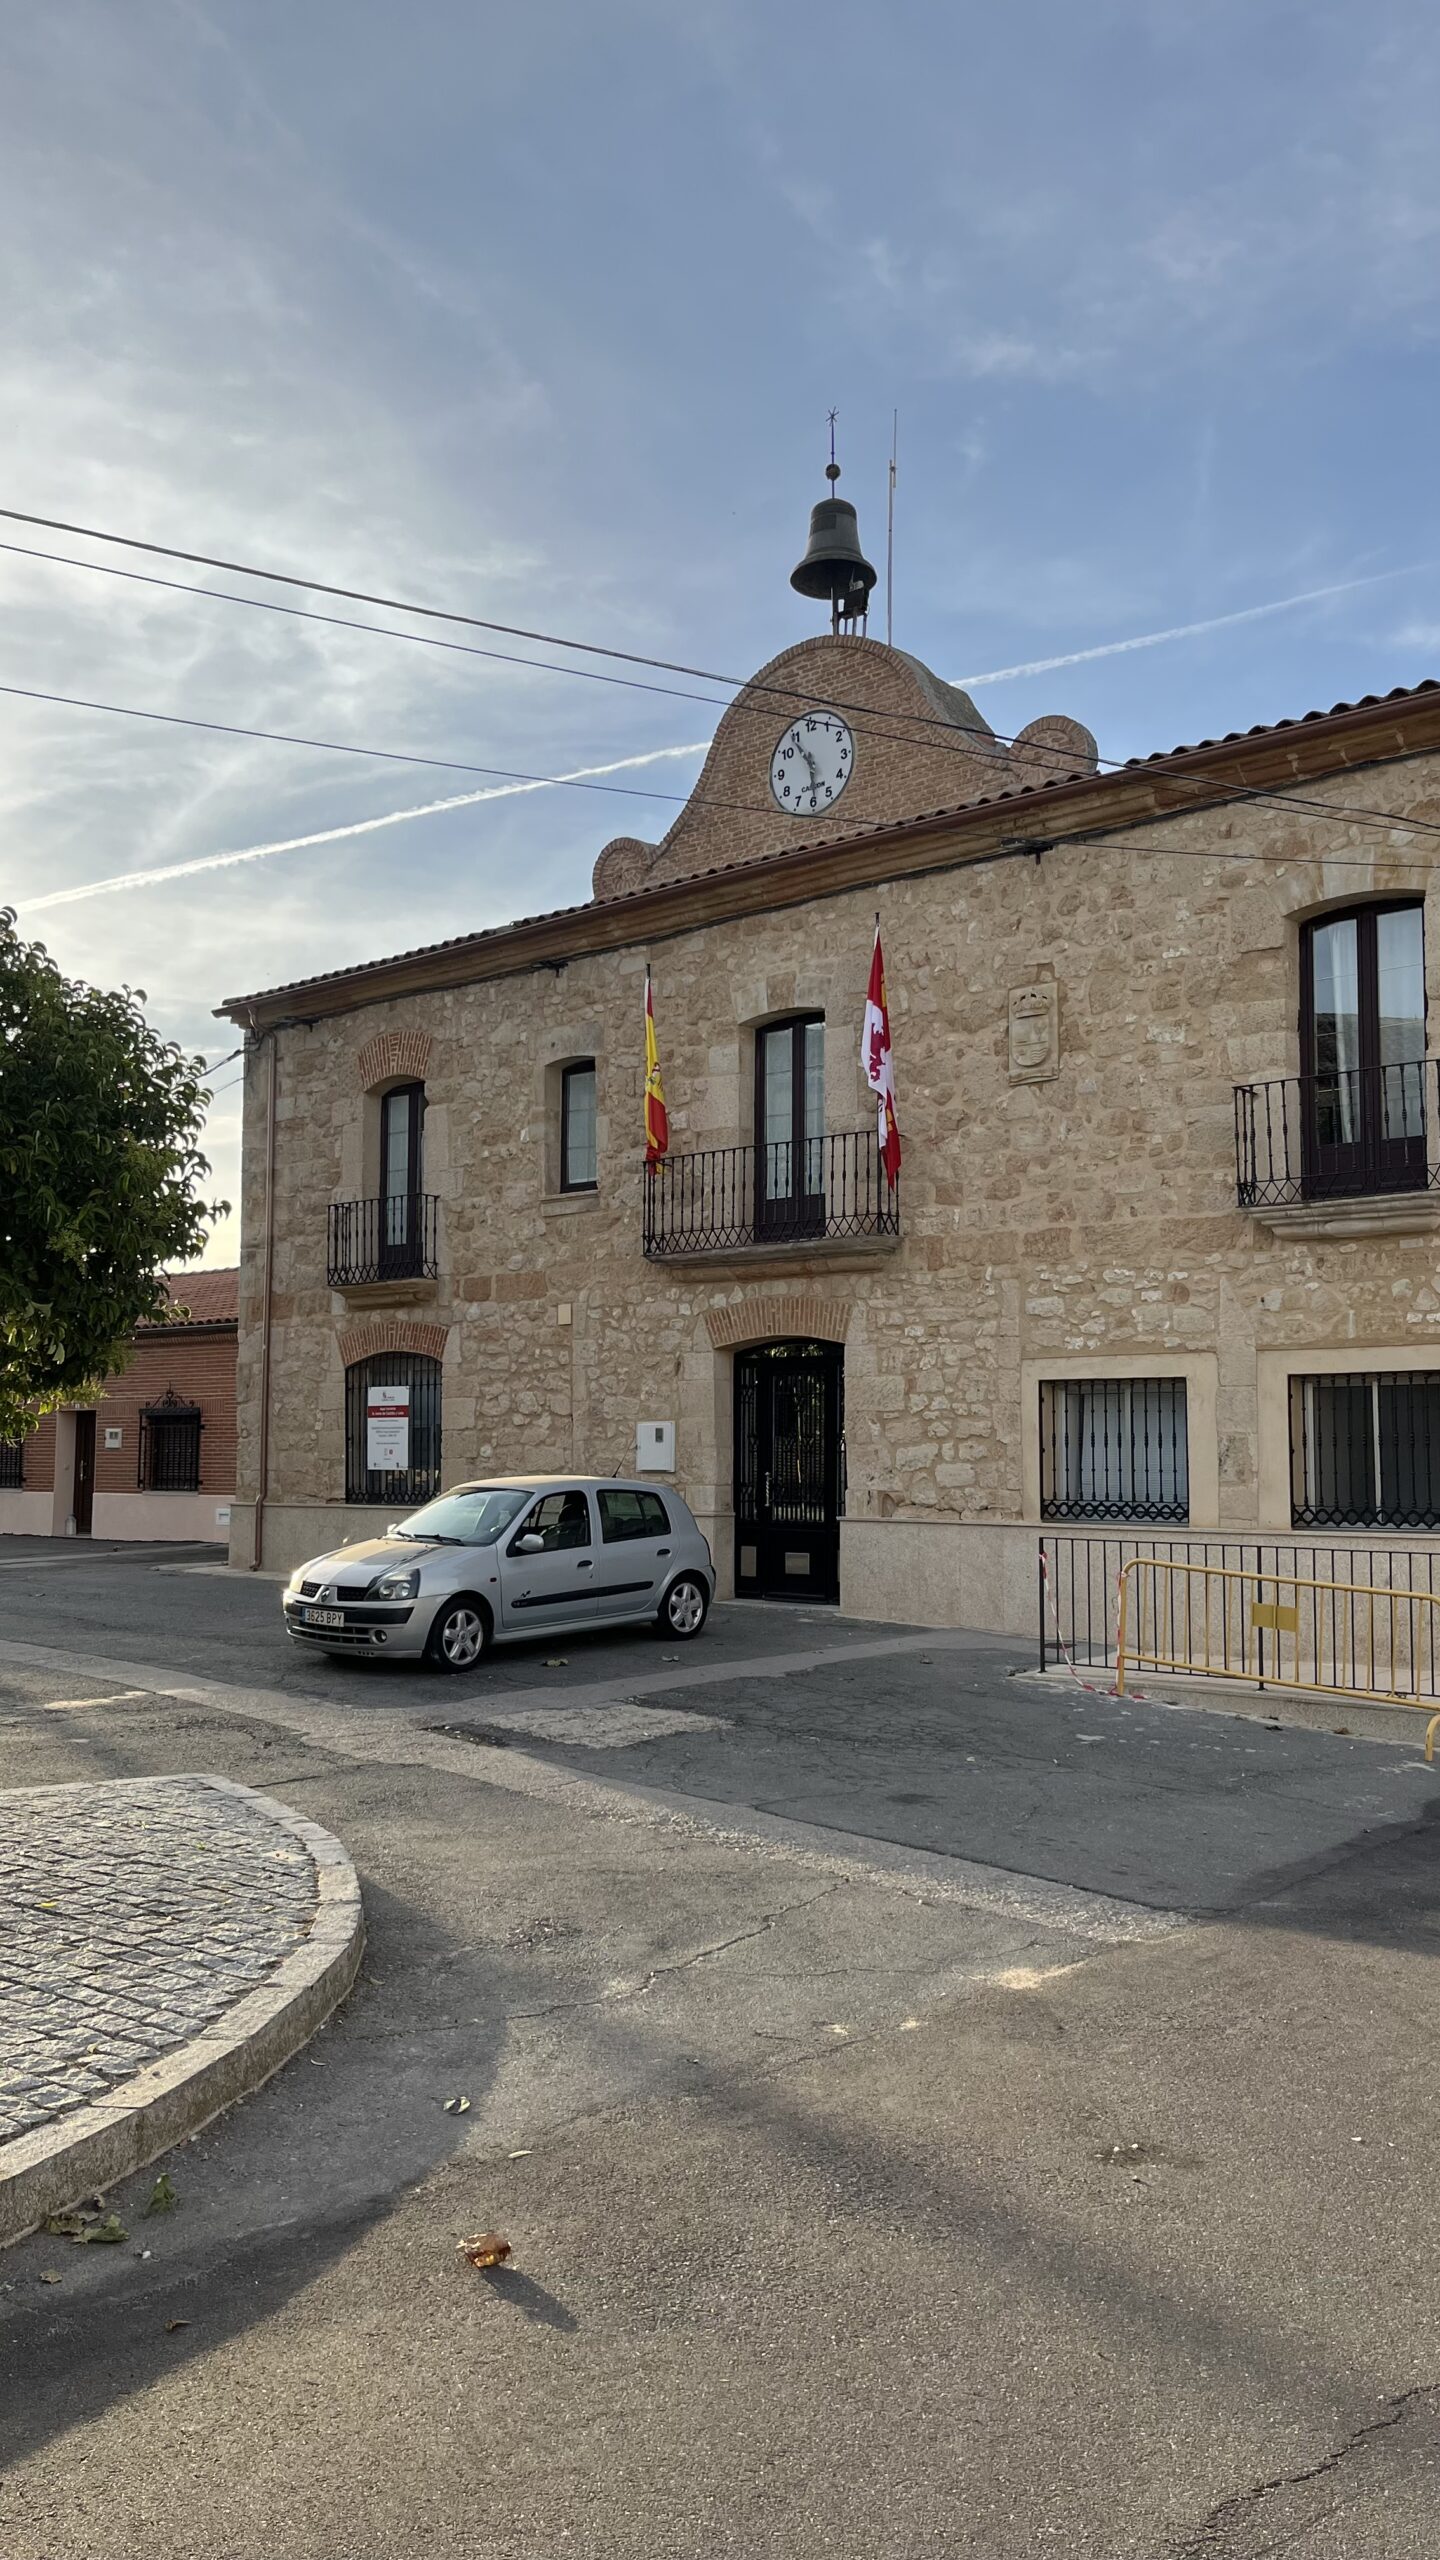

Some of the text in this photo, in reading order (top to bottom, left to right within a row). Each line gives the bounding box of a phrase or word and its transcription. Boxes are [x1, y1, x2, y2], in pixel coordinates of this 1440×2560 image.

[805, 720, 817, 732] 12
[825, 721, 830, 732] 1
[836, 731, 843, 742] 2
[781, 747, 794, 760] 10
[841, 749, 848, 760] 3
[778, 770, 785, 780] 9
[836, 768, 843, 779] 4
[783, 786, 790, 797] 8
[825, 786, 832, 797] 5
[795, 796, 801, 807] 7
[810, 796, 817, 807] 6
[306, 1610, 342, 1624] 3625 BPY
